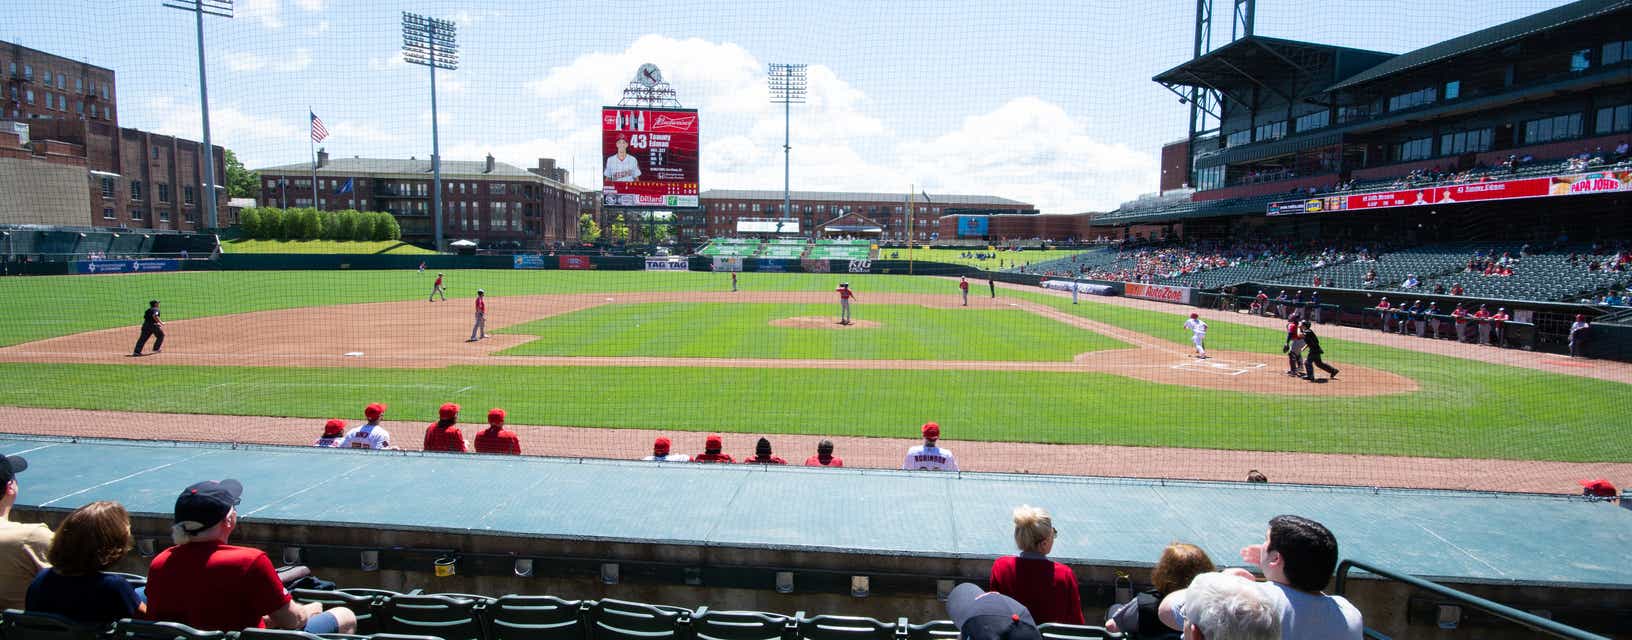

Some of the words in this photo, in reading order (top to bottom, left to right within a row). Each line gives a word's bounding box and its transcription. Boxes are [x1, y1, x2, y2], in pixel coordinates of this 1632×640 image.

[630, 134, 647, 149] 43
[1571, 180, 1591, 192] PAPA
[668, 261, 687, 269] TAG
[1145, 285, 1182, 300] AutoZone
[914, 455, 947, 465] ROBINSON
